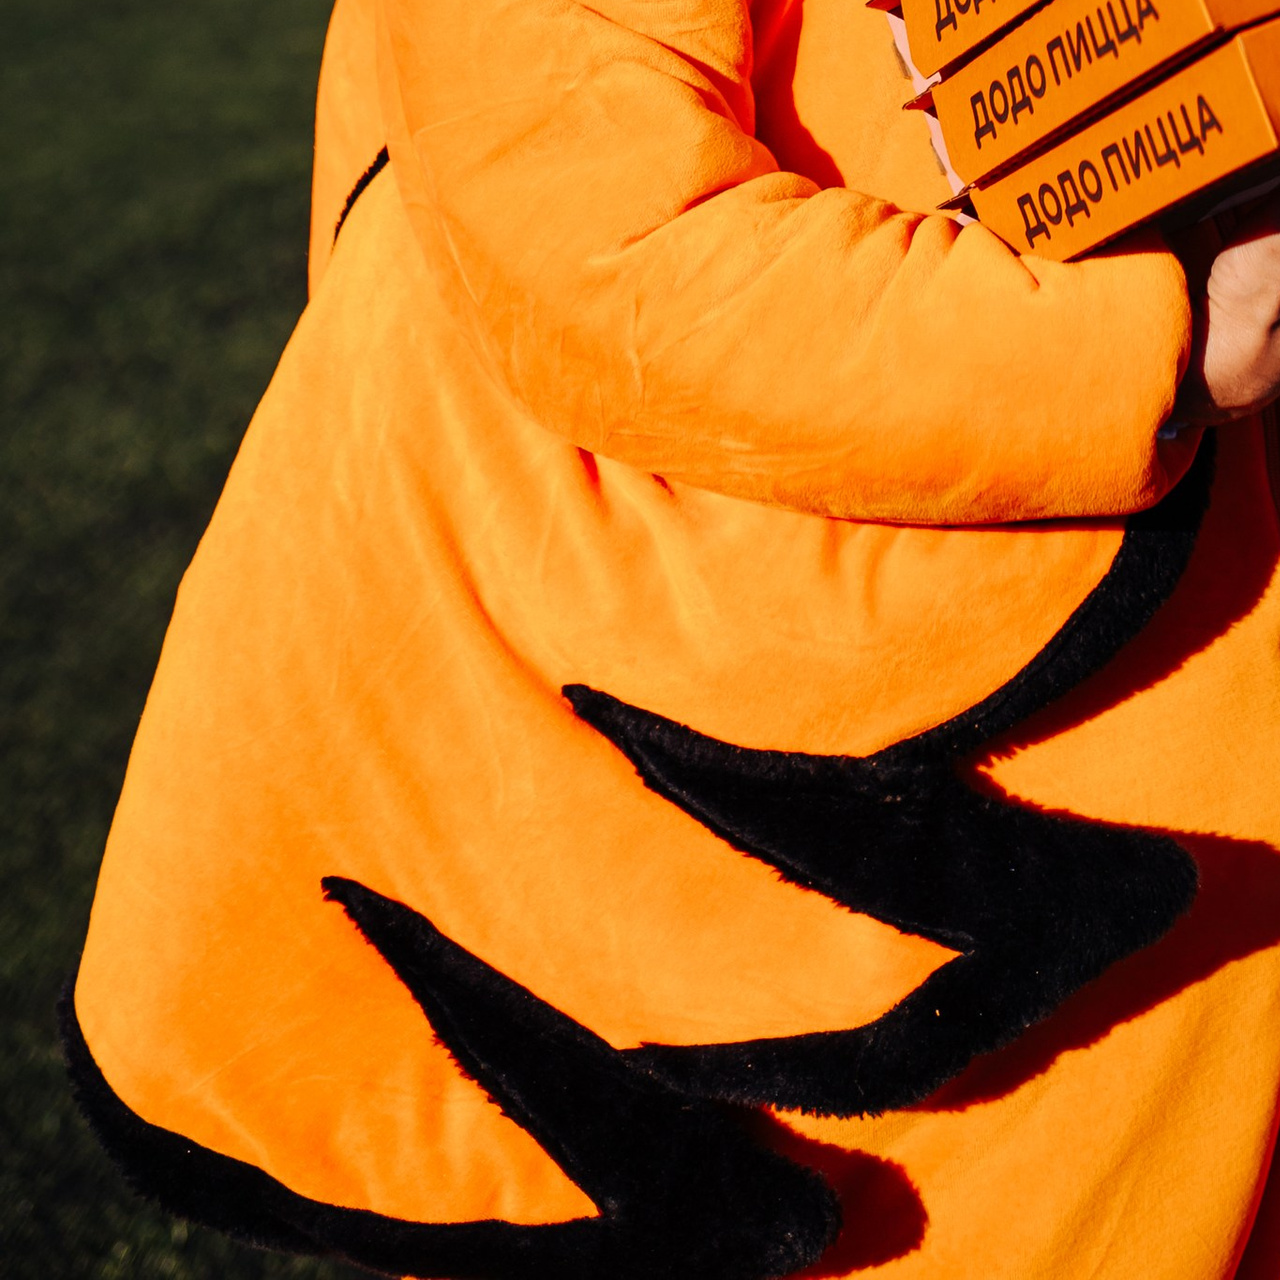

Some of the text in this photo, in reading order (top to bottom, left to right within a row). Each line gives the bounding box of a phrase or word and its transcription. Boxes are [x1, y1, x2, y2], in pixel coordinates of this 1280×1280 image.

[970, 55, 1046, 150] ДОДО
[1016, 96, 1222, 248] ДОДО ПИЦЦА
